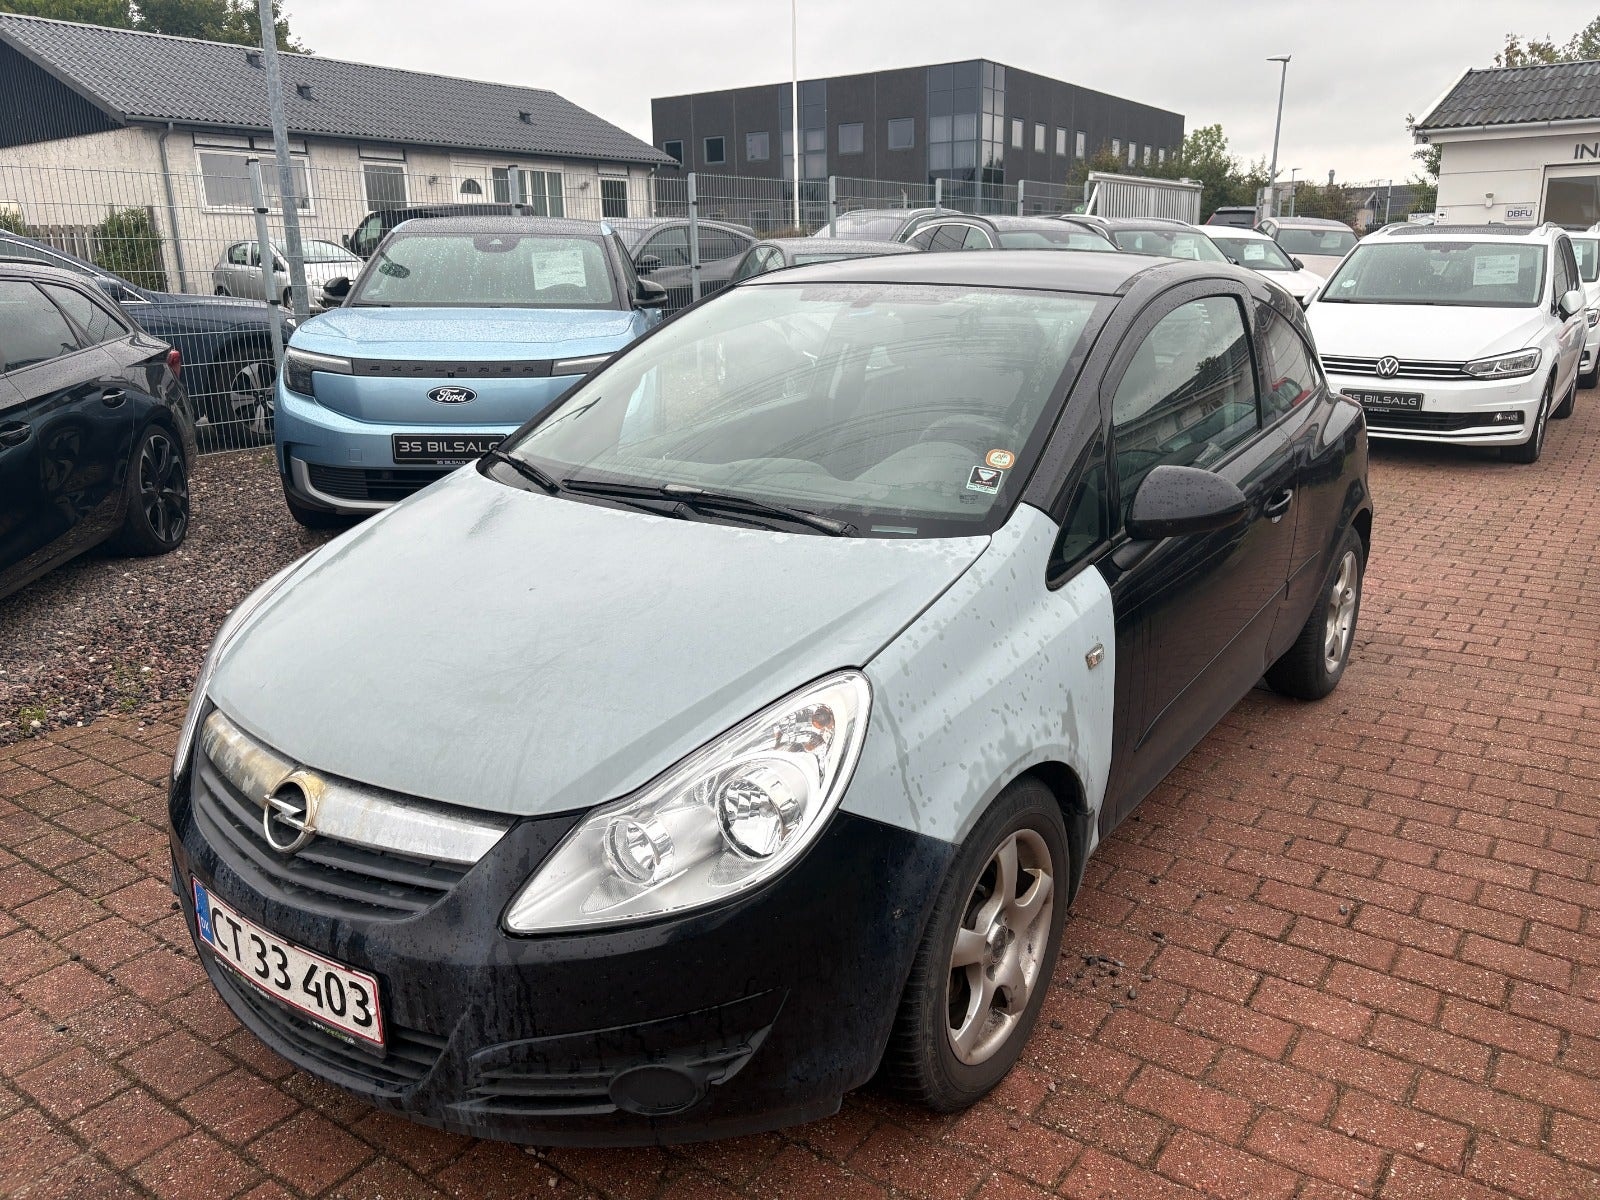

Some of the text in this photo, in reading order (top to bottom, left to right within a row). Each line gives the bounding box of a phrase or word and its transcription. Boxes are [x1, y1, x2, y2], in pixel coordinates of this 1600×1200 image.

[1574, 142, 1600, 159] IN
[369, 365, 534, 373] EXPLORER
[436, 388, 467, 402] Ford
[1364, 394, 1417, 406] BILSALG
[399, 441, 422, 453] 3S
[200, 916, 210, 934] DK
[211, 906, 242, 962] CT
[250, 932, 292, 991] 33
[302, 963, 373, 1028] 403
